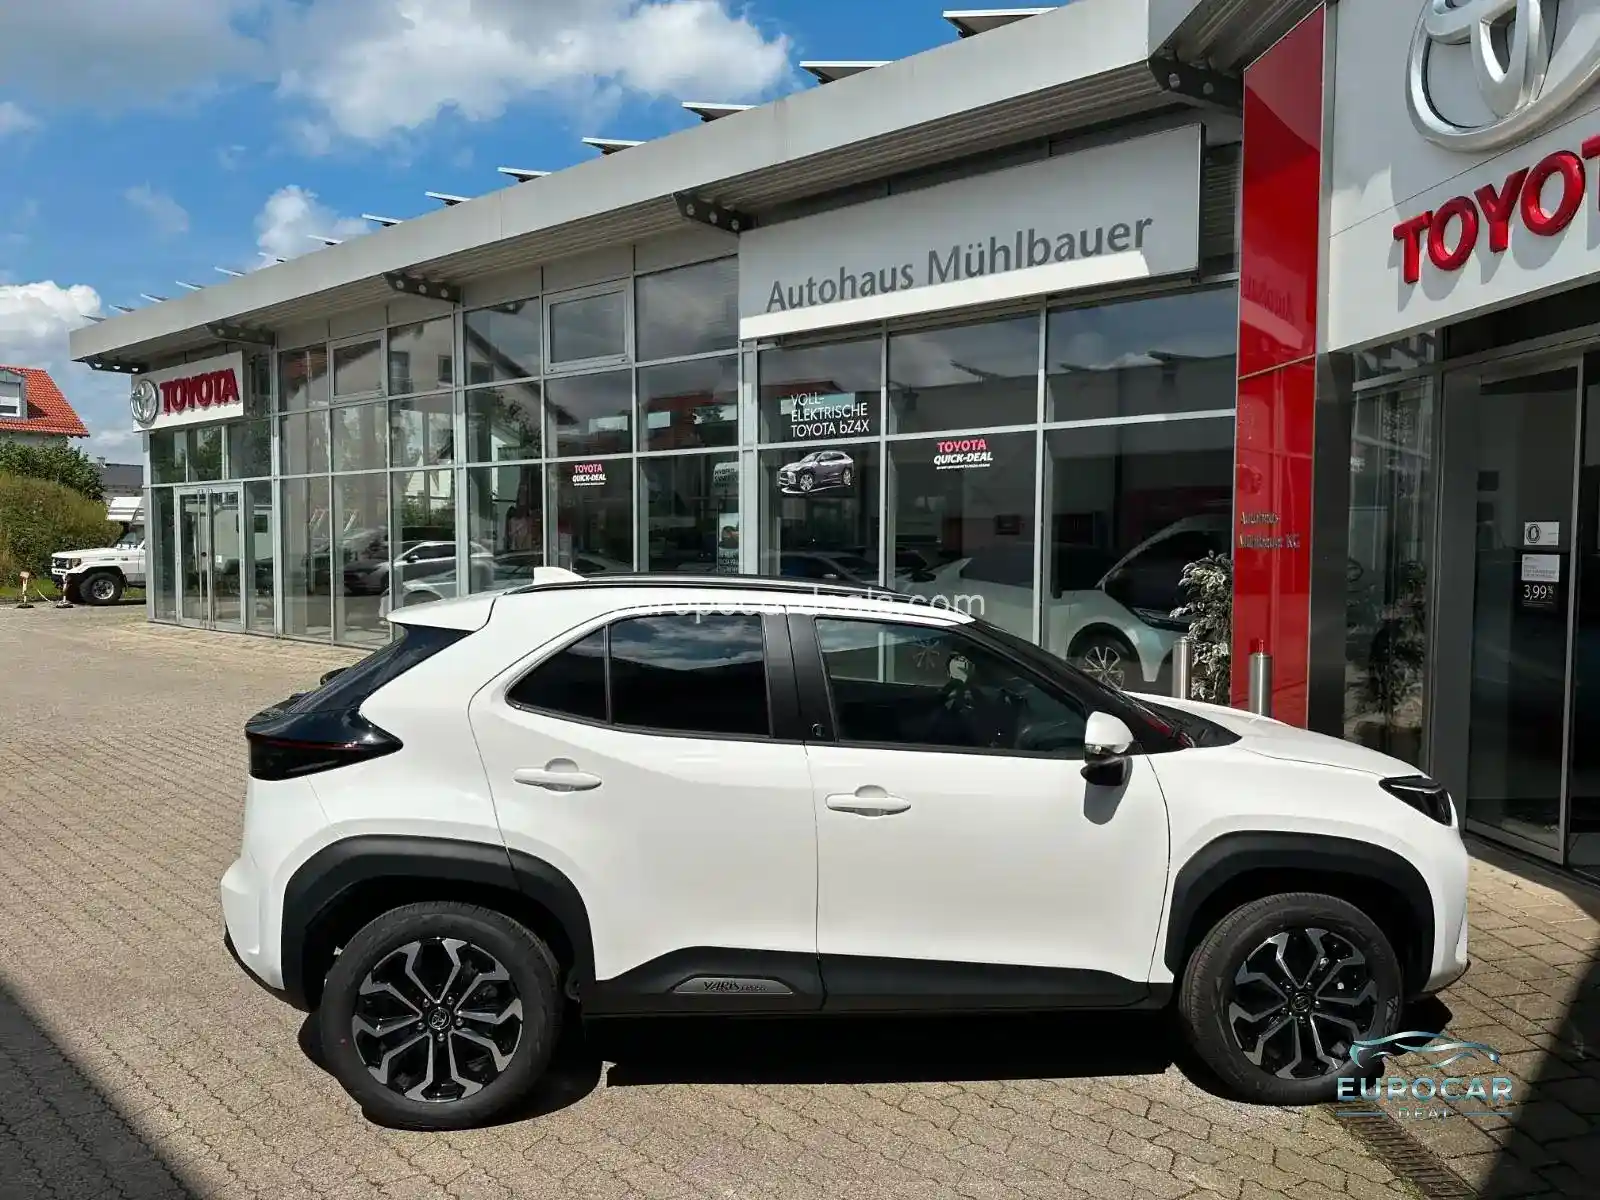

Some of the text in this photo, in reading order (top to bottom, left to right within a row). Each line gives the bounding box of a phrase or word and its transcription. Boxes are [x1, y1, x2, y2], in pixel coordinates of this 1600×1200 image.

[767, 217, 1153, 313] Autohaus Mühlbauer
[160, 368, 240, 415] TOYOTA
[791, 391, 825, 406] VOLL-
[791, 402, 868, 422] ELEKTRISCHE
[790, 419, 869, 437] TOYOTA bZ4X
[937, 439, 987, 453] TOYOTA
[933, 451, 994, 466] QUICK-DEAL
[574, 463, 603, 473] TOYOTA
[572, 473, 607, 483] QUICK-DEAL
